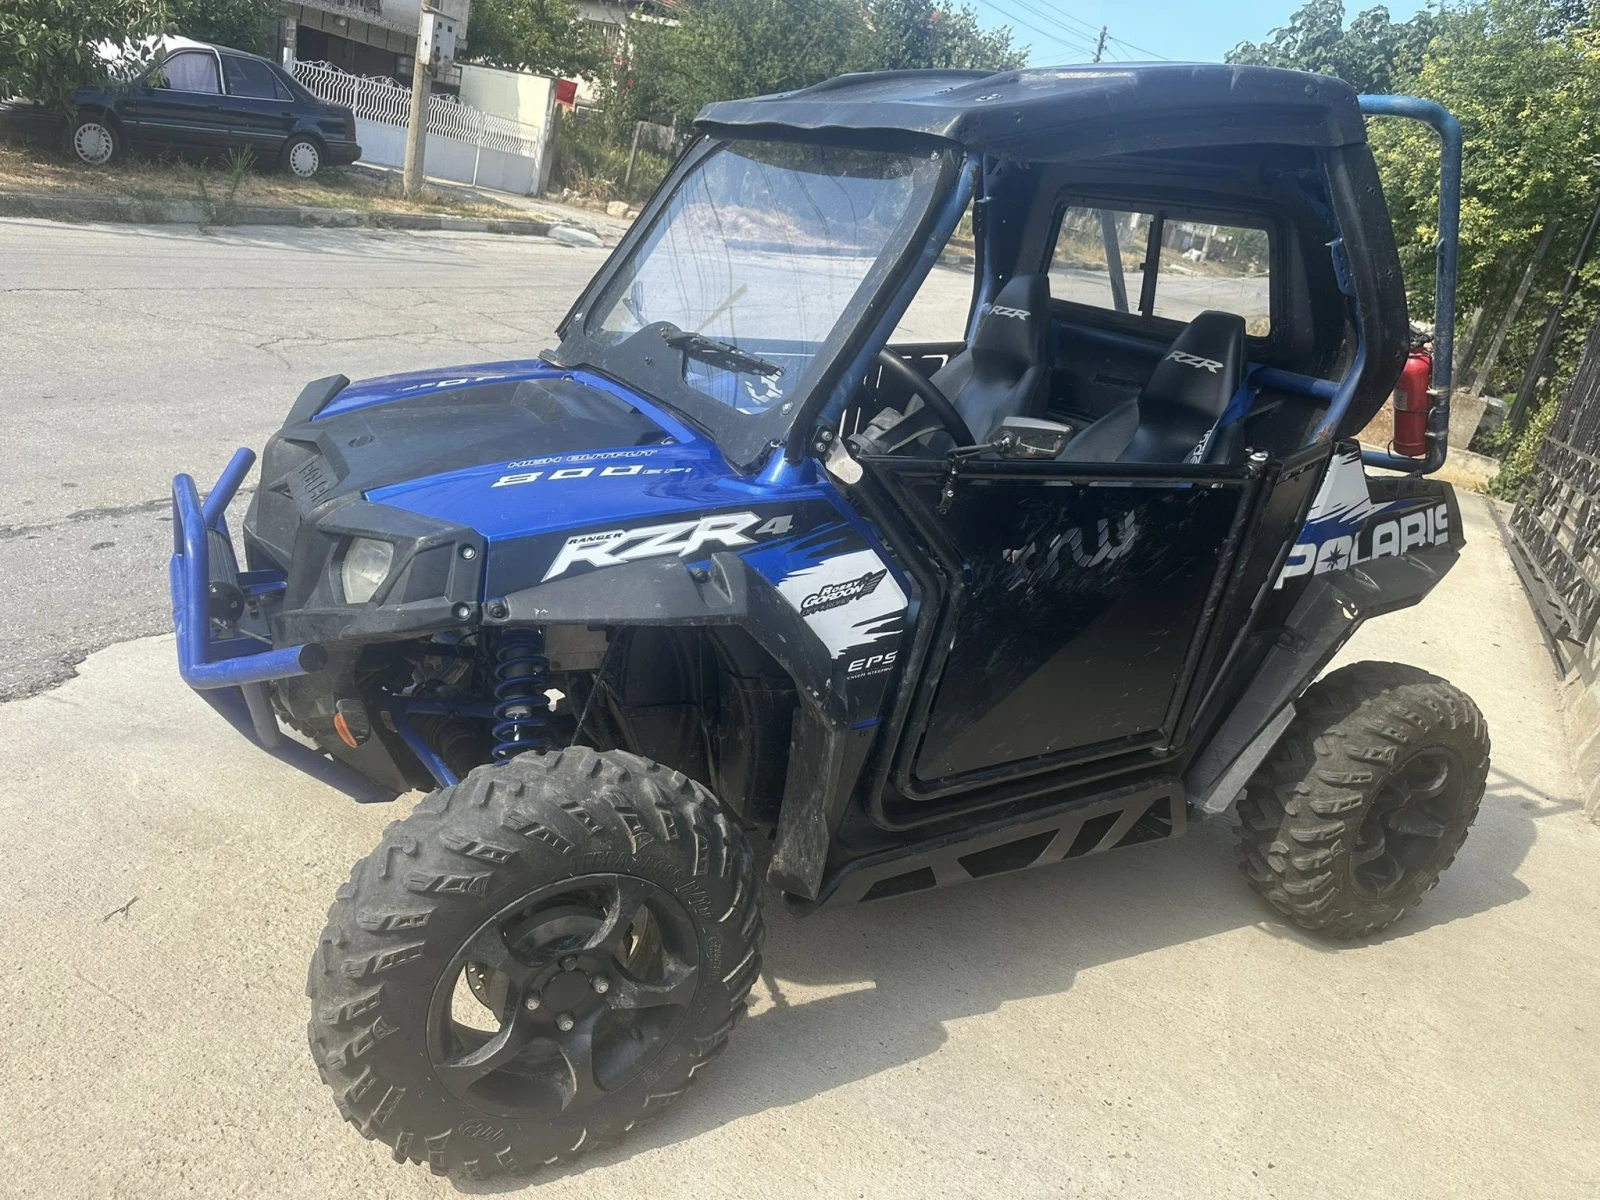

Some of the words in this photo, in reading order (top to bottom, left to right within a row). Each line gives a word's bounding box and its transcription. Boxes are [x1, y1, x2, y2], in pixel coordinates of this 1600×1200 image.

[989, 305, 1031, 321] RZR
[1165, 350, 1224, 374] RZR
[507, 457, 562, 469] HIGH
[567, 450, 658, 462] OUTPUT
[491, 465, 644, 488] 800
[541, 511, 762, 583] RZR
[755, 515, 793, 535] 4
[568, 532, 624, 545] RANGER
[1273, 504, 1449, 590] POLARIS
[803, 584, 864, 608] GORDON
[820, 580, 860, 596] ROBBY
[847, 650, 898, 672] EPS
